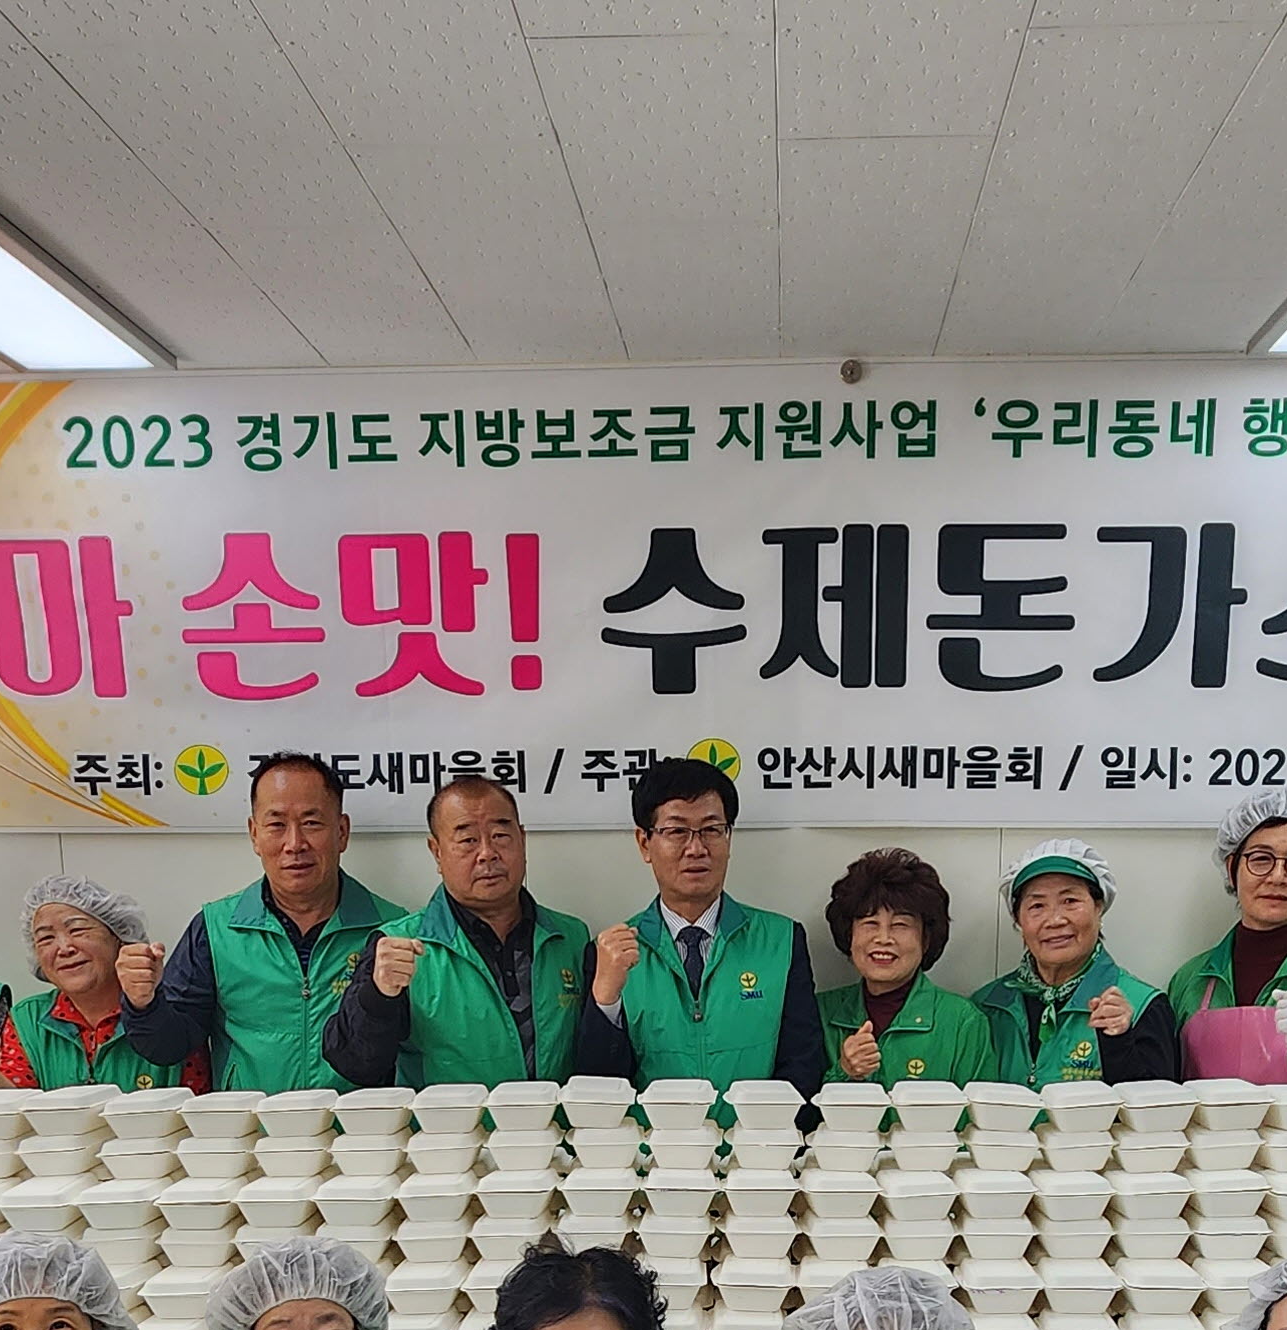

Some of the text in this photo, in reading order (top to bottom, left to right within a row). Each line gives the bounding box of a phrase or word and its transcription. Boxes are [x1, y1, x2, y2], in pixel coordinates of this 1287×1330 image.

[61, 413, 214, 470] 2023
[237, 411, 400, 472] 경기도
[418, 407, 696, 468] 지방보조금
[717, 402, 938, 461] 지원사업
[181, 530, 542, 701] 손맛!
[73, 753, 164, 796] 주최:
[543, 748, 565, 795] /
[756, 745, 1044, 790] 안산시새마을회
[1058, 744, 1085, 791] /
[1100, 746, 1194, 790] 일시:
